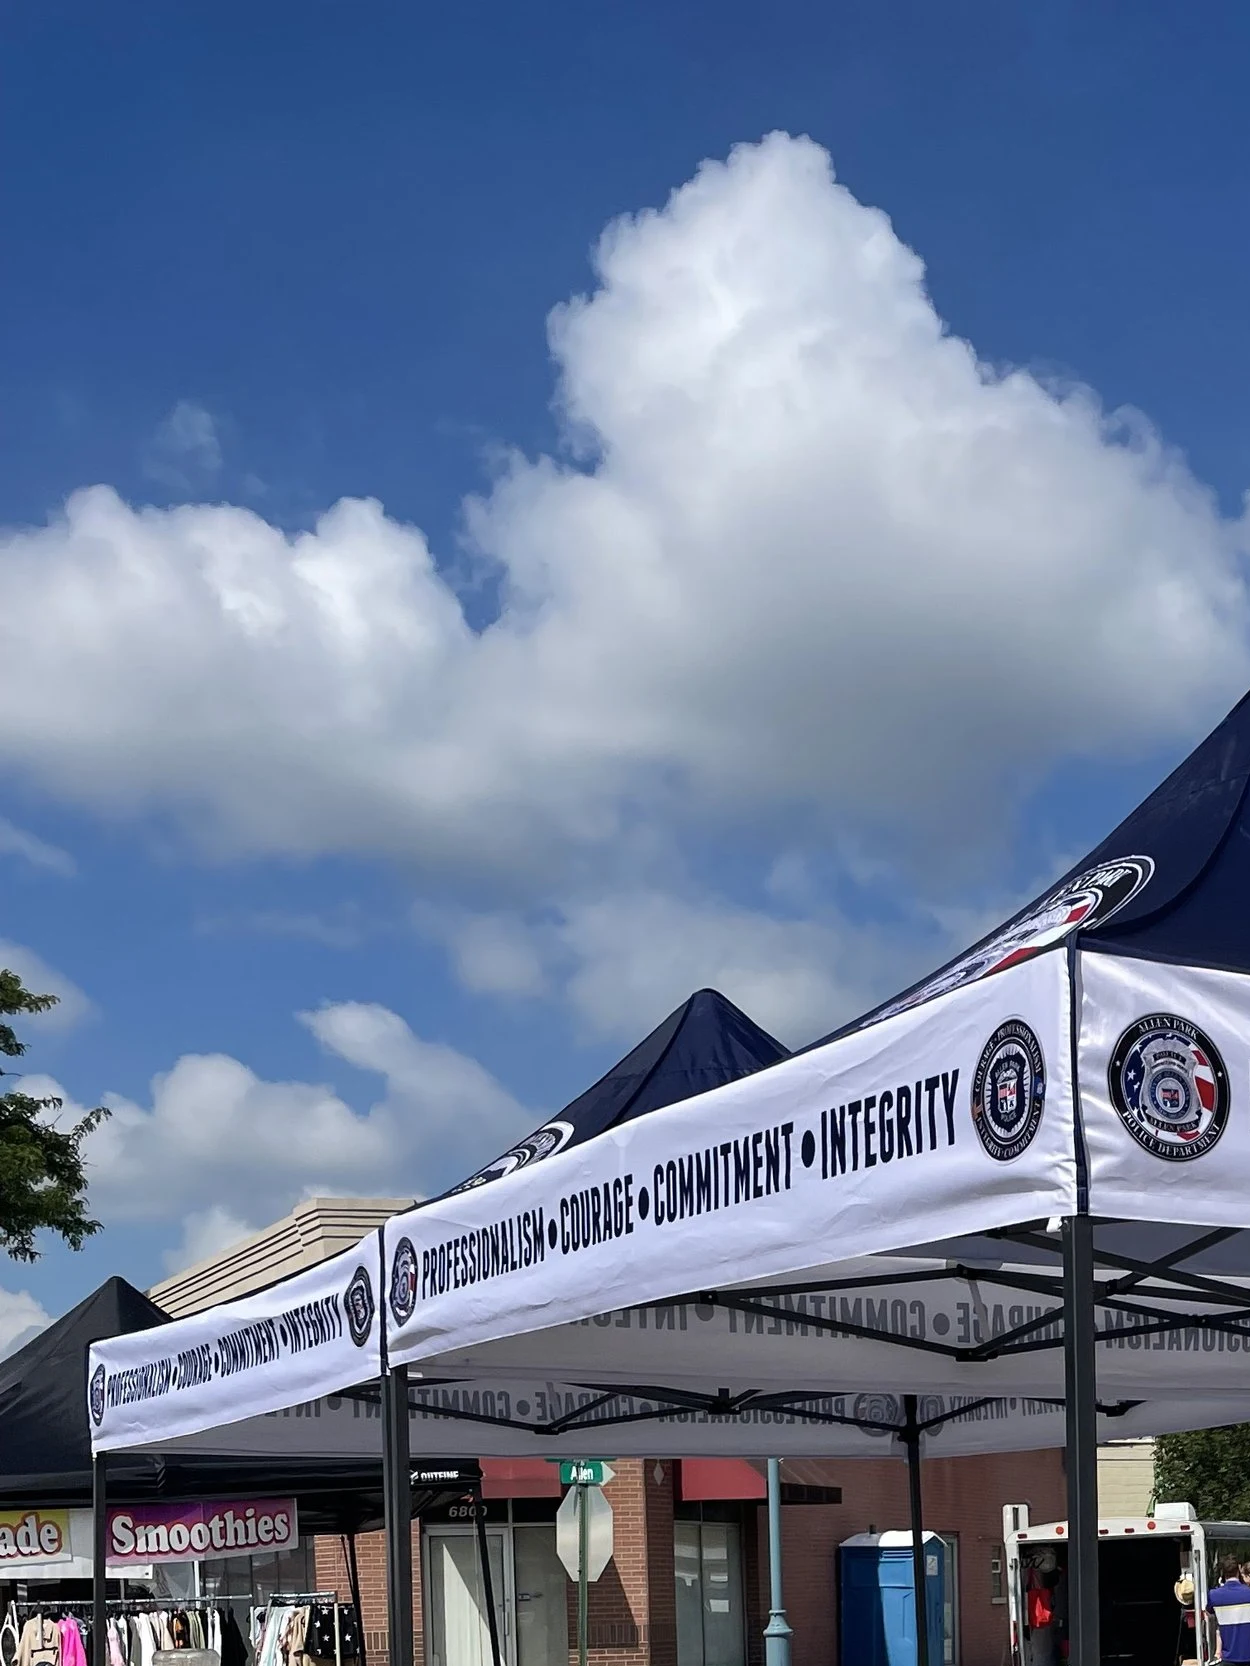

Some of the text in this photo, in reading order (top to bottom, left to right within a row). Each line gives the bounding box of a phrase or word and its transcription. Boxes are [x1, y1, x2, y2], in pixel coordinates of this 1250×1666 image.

[1139, 1017, 1199, 1041] ALLEN PARK
[1122, 1110, 1220, 1157] POLICE DEPARTMENT
[421, 1206, 546, 1300] PROFESSIONALISM
[559, 1173, 635, 1256] COURAGE
[652, 1120, 795, 1227] COMMITMENT
[819, 1068, 960, 1181] INTEGRITY
[176, 1343, 213, 1391] COURAGE
[217, 1318, 280, 1378] COMMITMENT
[281, 1292, 343, 1355] INTEGRITY
[111, 1508, 291, 1555] Smoothies
